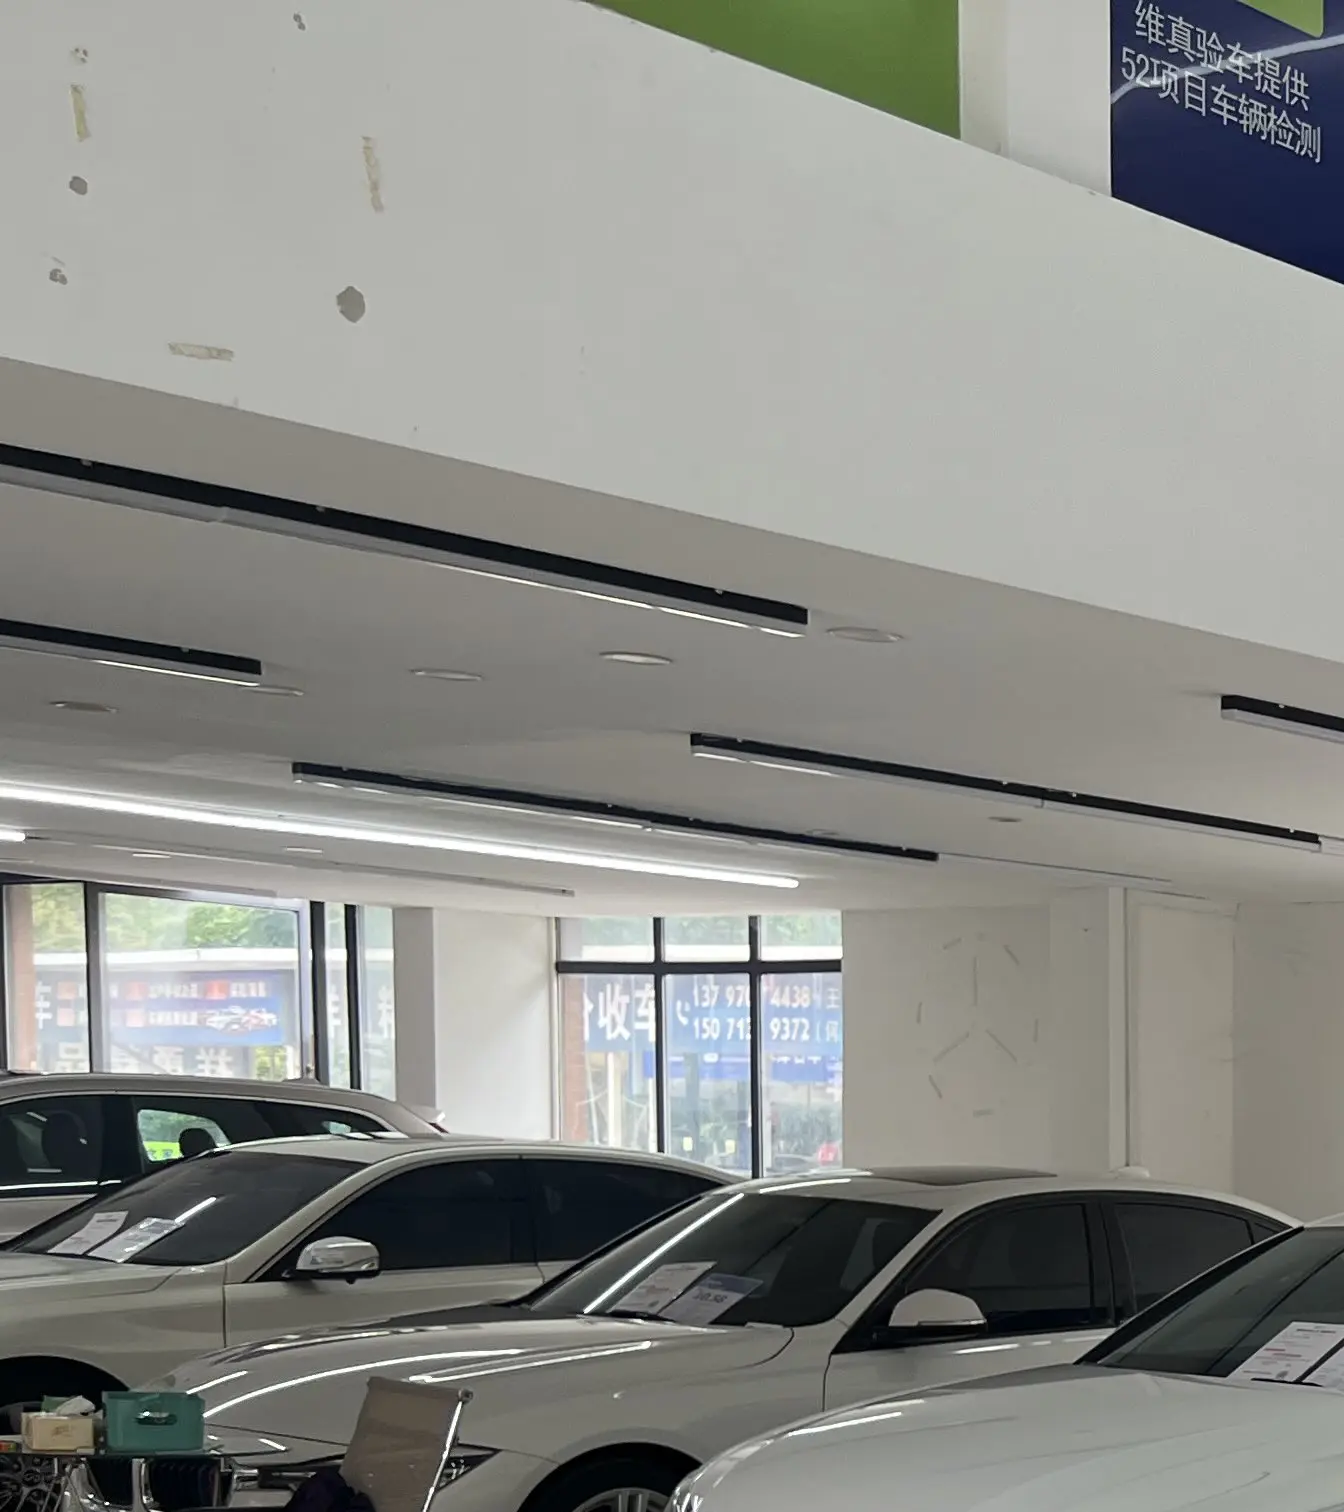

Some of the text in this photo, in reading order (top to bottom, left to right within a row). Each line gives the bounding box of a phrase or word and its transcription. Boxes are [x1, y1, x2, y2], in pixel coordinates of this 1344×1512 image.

[1121, 46, 1321, 163] 52项目车辆检测
[1134, 0, 1310, 112] 维真验车提供
[583, 983, 656, 1043] 收车
